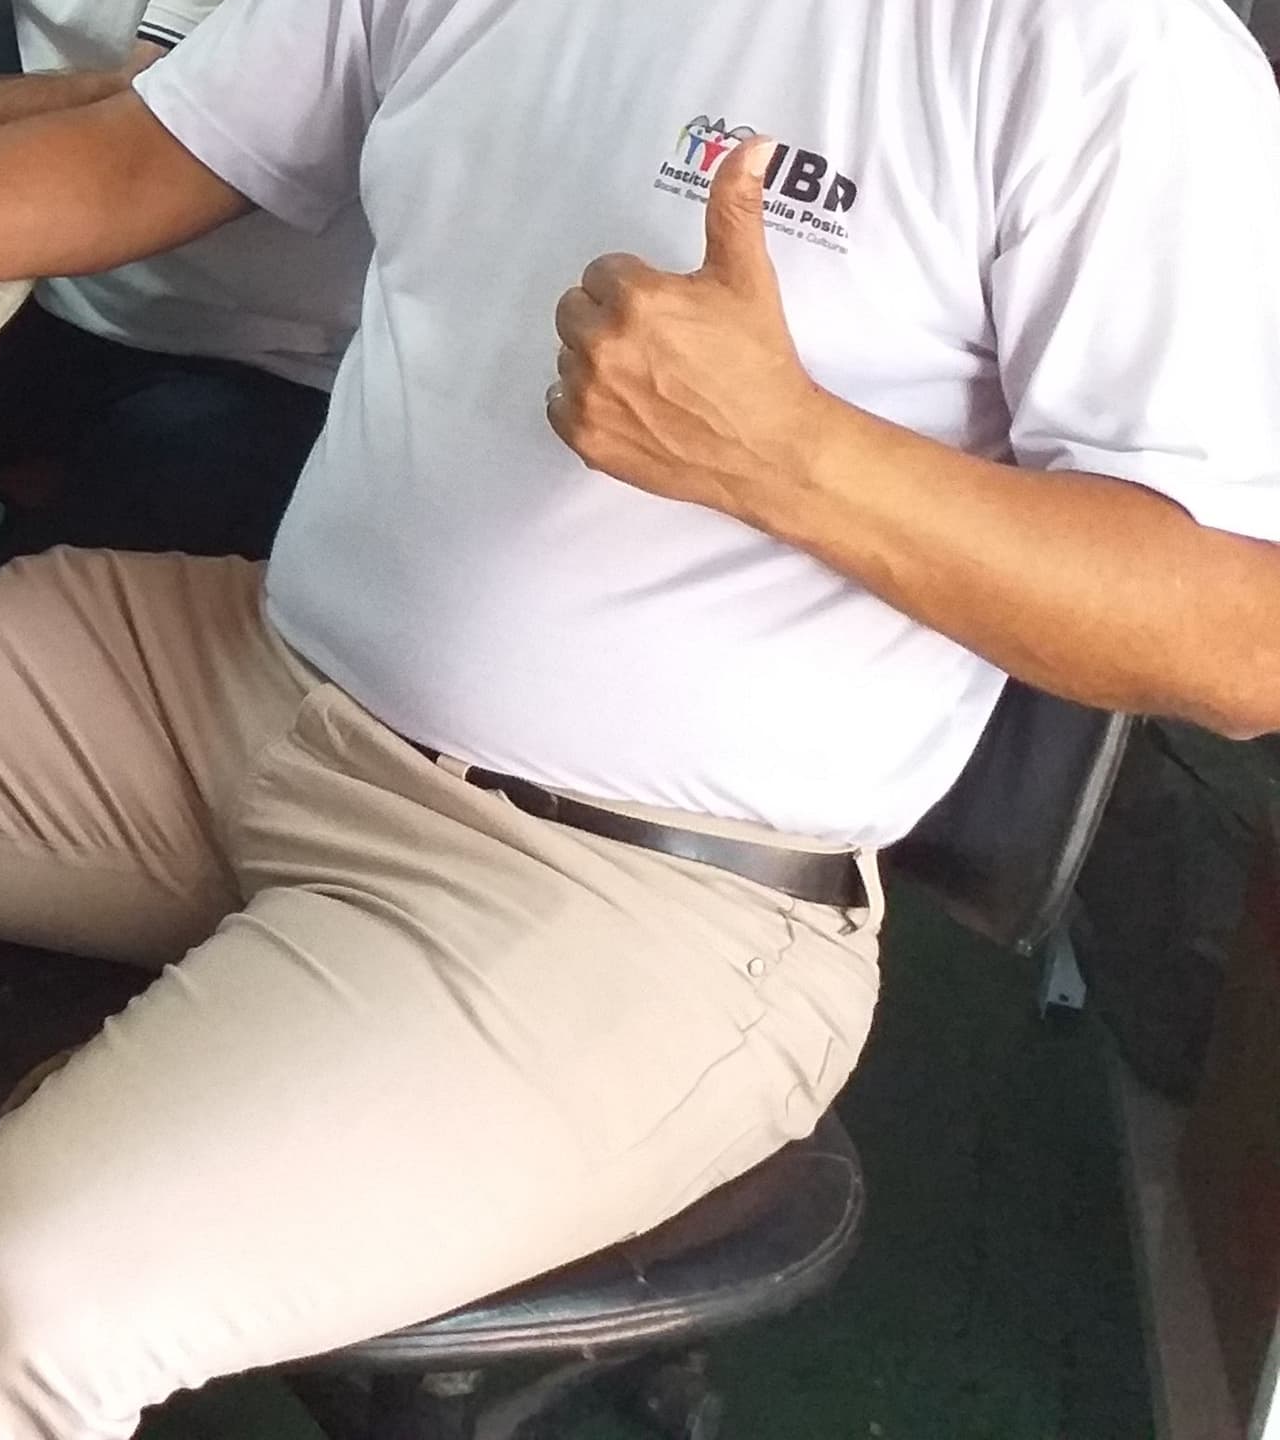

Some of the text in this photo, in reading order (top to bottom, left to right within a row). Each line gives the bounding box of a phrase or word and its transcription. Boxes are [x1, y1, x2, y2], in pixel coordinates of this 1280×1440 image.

[660, 162, 849, 238] Institu sília Posit
